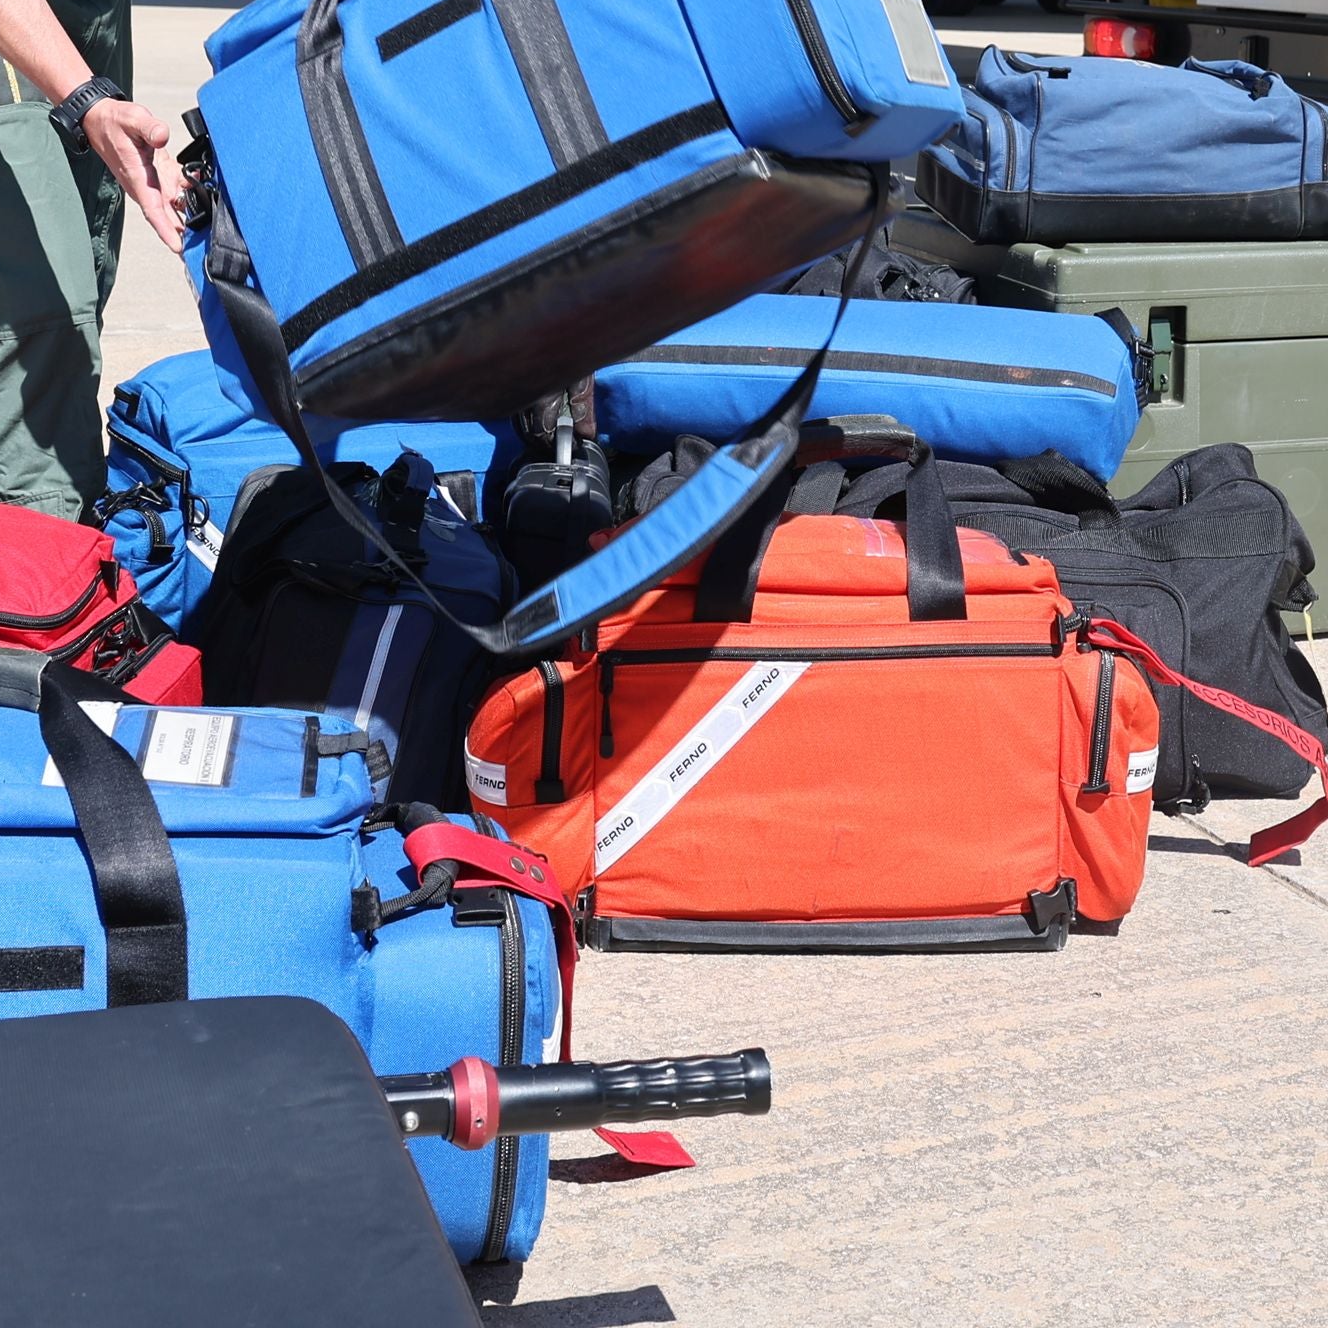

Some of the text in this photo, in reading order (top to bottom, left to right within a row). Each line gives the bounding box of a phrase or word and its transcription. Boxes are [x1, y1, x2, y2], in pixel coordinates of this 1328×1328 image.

[742, 668, 780, 708] FERNO
[210, 717, 221, 733] EQUIPO
[1193, 684, 1310, 753] ACCESORIOS
[179, 728, 196, 765] RESPIRATORIO
[669, 742, 707, 782] FERNO
[475, 773, 506, 790] FERNO
[597, 816, 634, 852] FERNO
